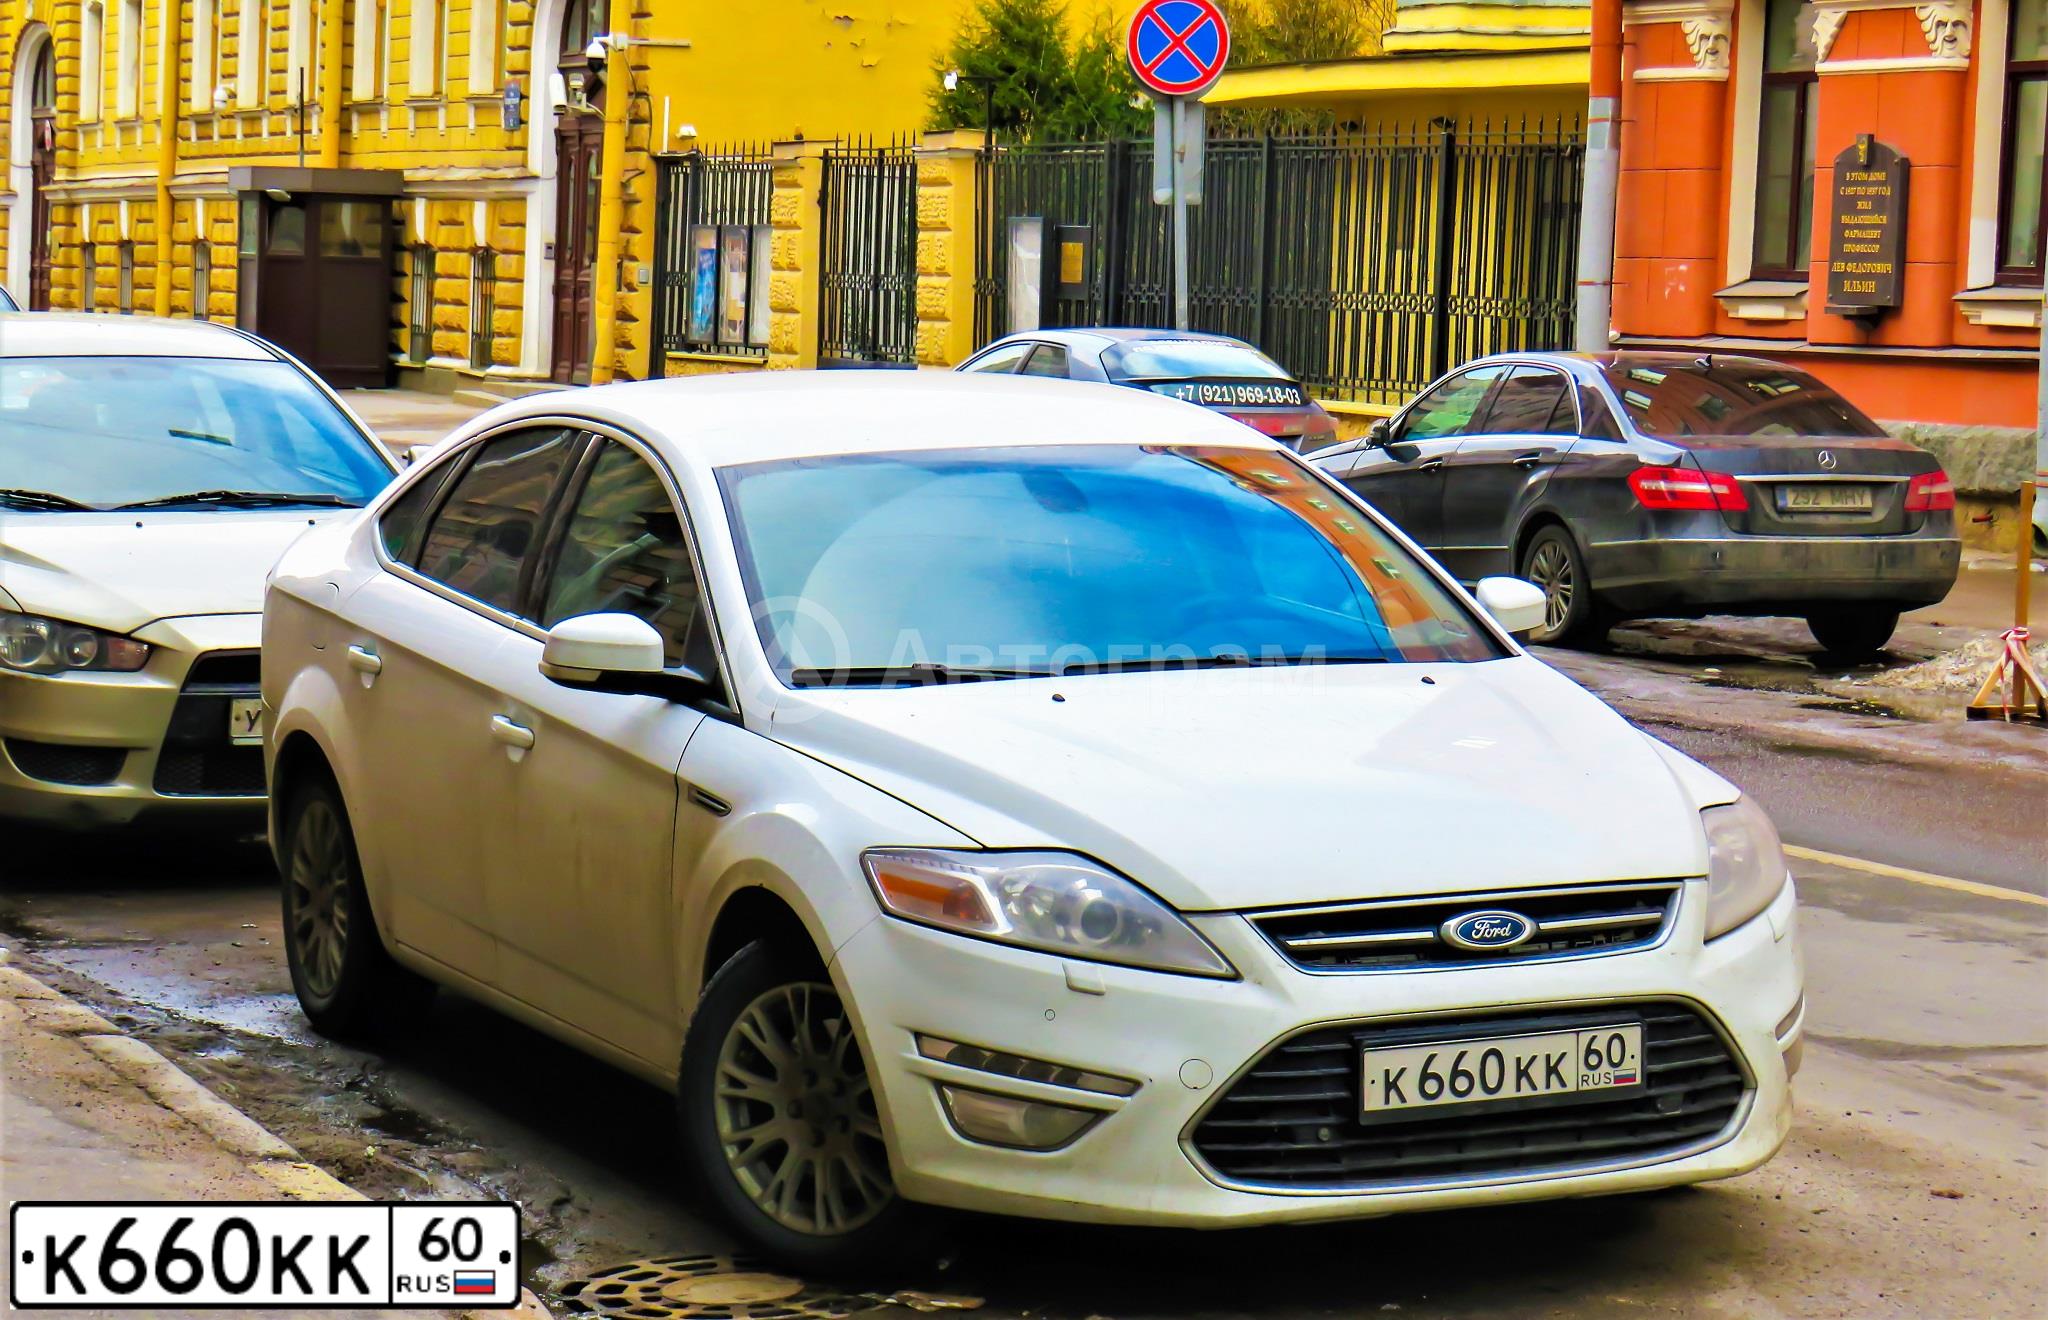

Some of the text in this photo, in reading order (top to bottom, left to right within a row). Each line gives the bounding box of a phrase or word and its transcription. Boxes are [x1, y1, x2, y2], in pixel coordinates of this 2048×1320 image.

[1856, 201, 1872, 209] ЖИЛ
[1841, 214, 1887, 224] ВЫДАЮЩИЙСЯ
[1844, 229, 1881, 238] ФАРМАЦЕВТ
[1843, 244, 1880, 253] ПРОФЕССОР
[1831, 262, 1892, 273] ЛЕВ ФЕДОРОВИЧ
[1843, 280, 1876, 293] ИЛЬИН
[1176, 385, 1301, 405] +7 (921) 969-18-03
[1472, 919, 1512, 939] Ford
[1584, 1032, 1626, 1071] 60
[1580, 1072, 1612, 1087] RUS
